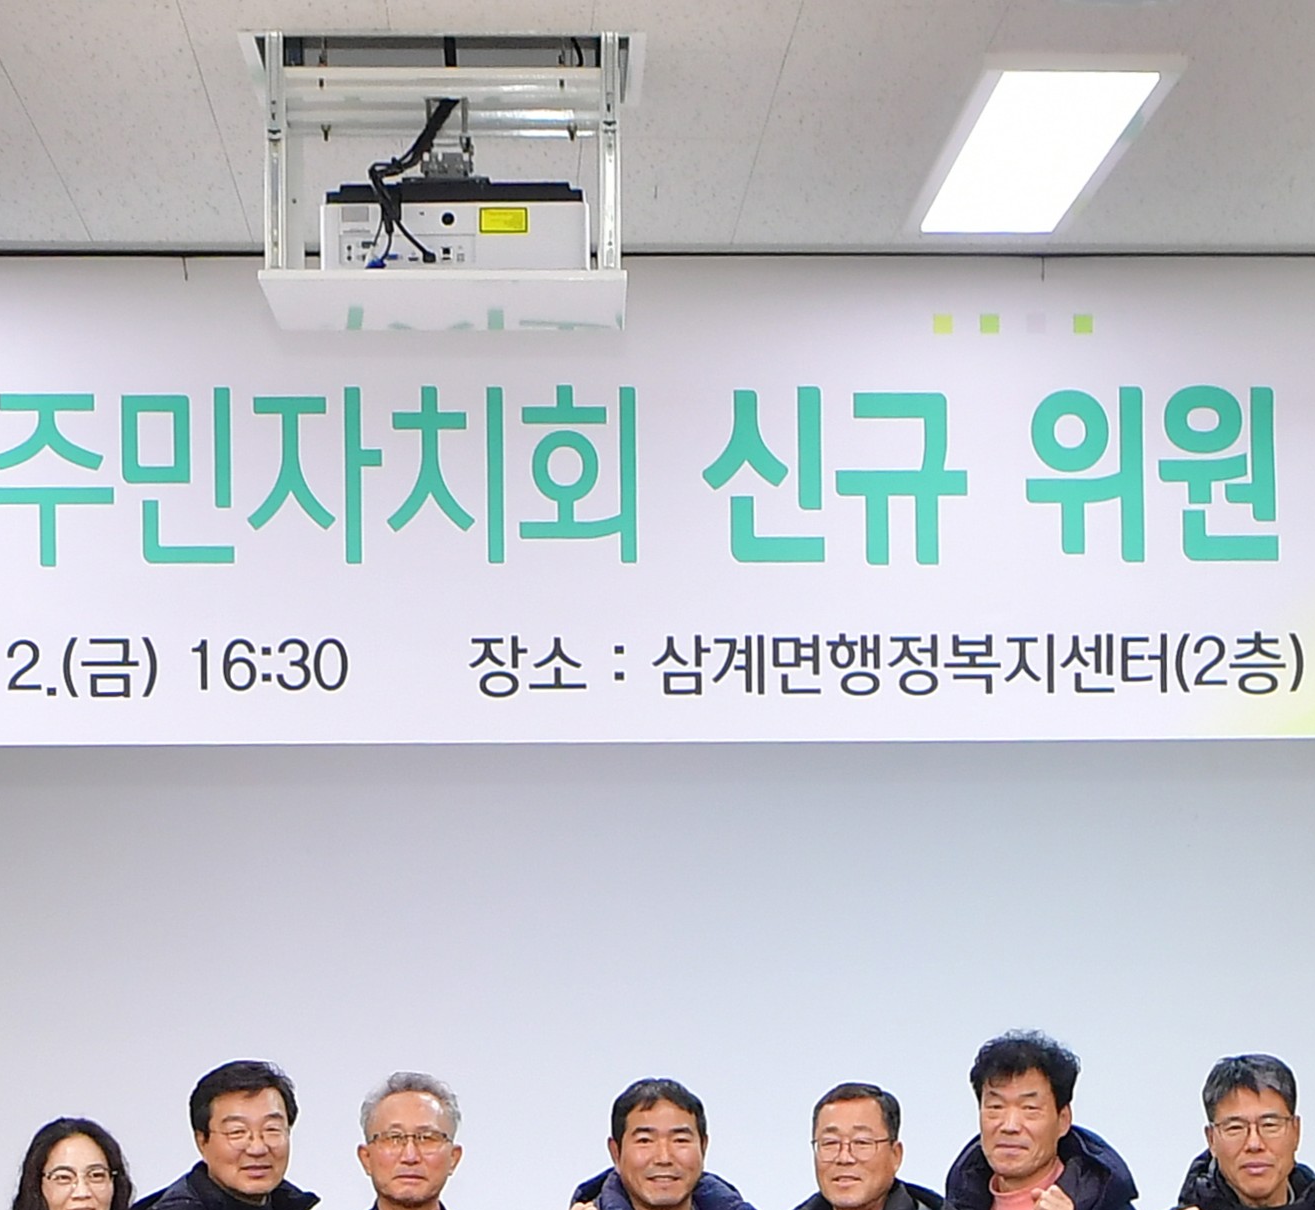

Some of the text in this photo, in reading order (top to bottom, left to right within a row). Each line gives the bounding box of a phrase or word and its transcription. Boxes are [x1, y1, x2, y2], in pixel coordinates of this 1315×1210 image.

[702, 385, 968, 566] 신규
[1025, 384, 1280, 564] 위원
[6, 636, 158, 699] 2.(금)
[191, 638, 349, 692] 16:30
[469, 634, 589, 699] 장소
[651, 631, 1306, 697] 삼계면행정복지센터(2층)
